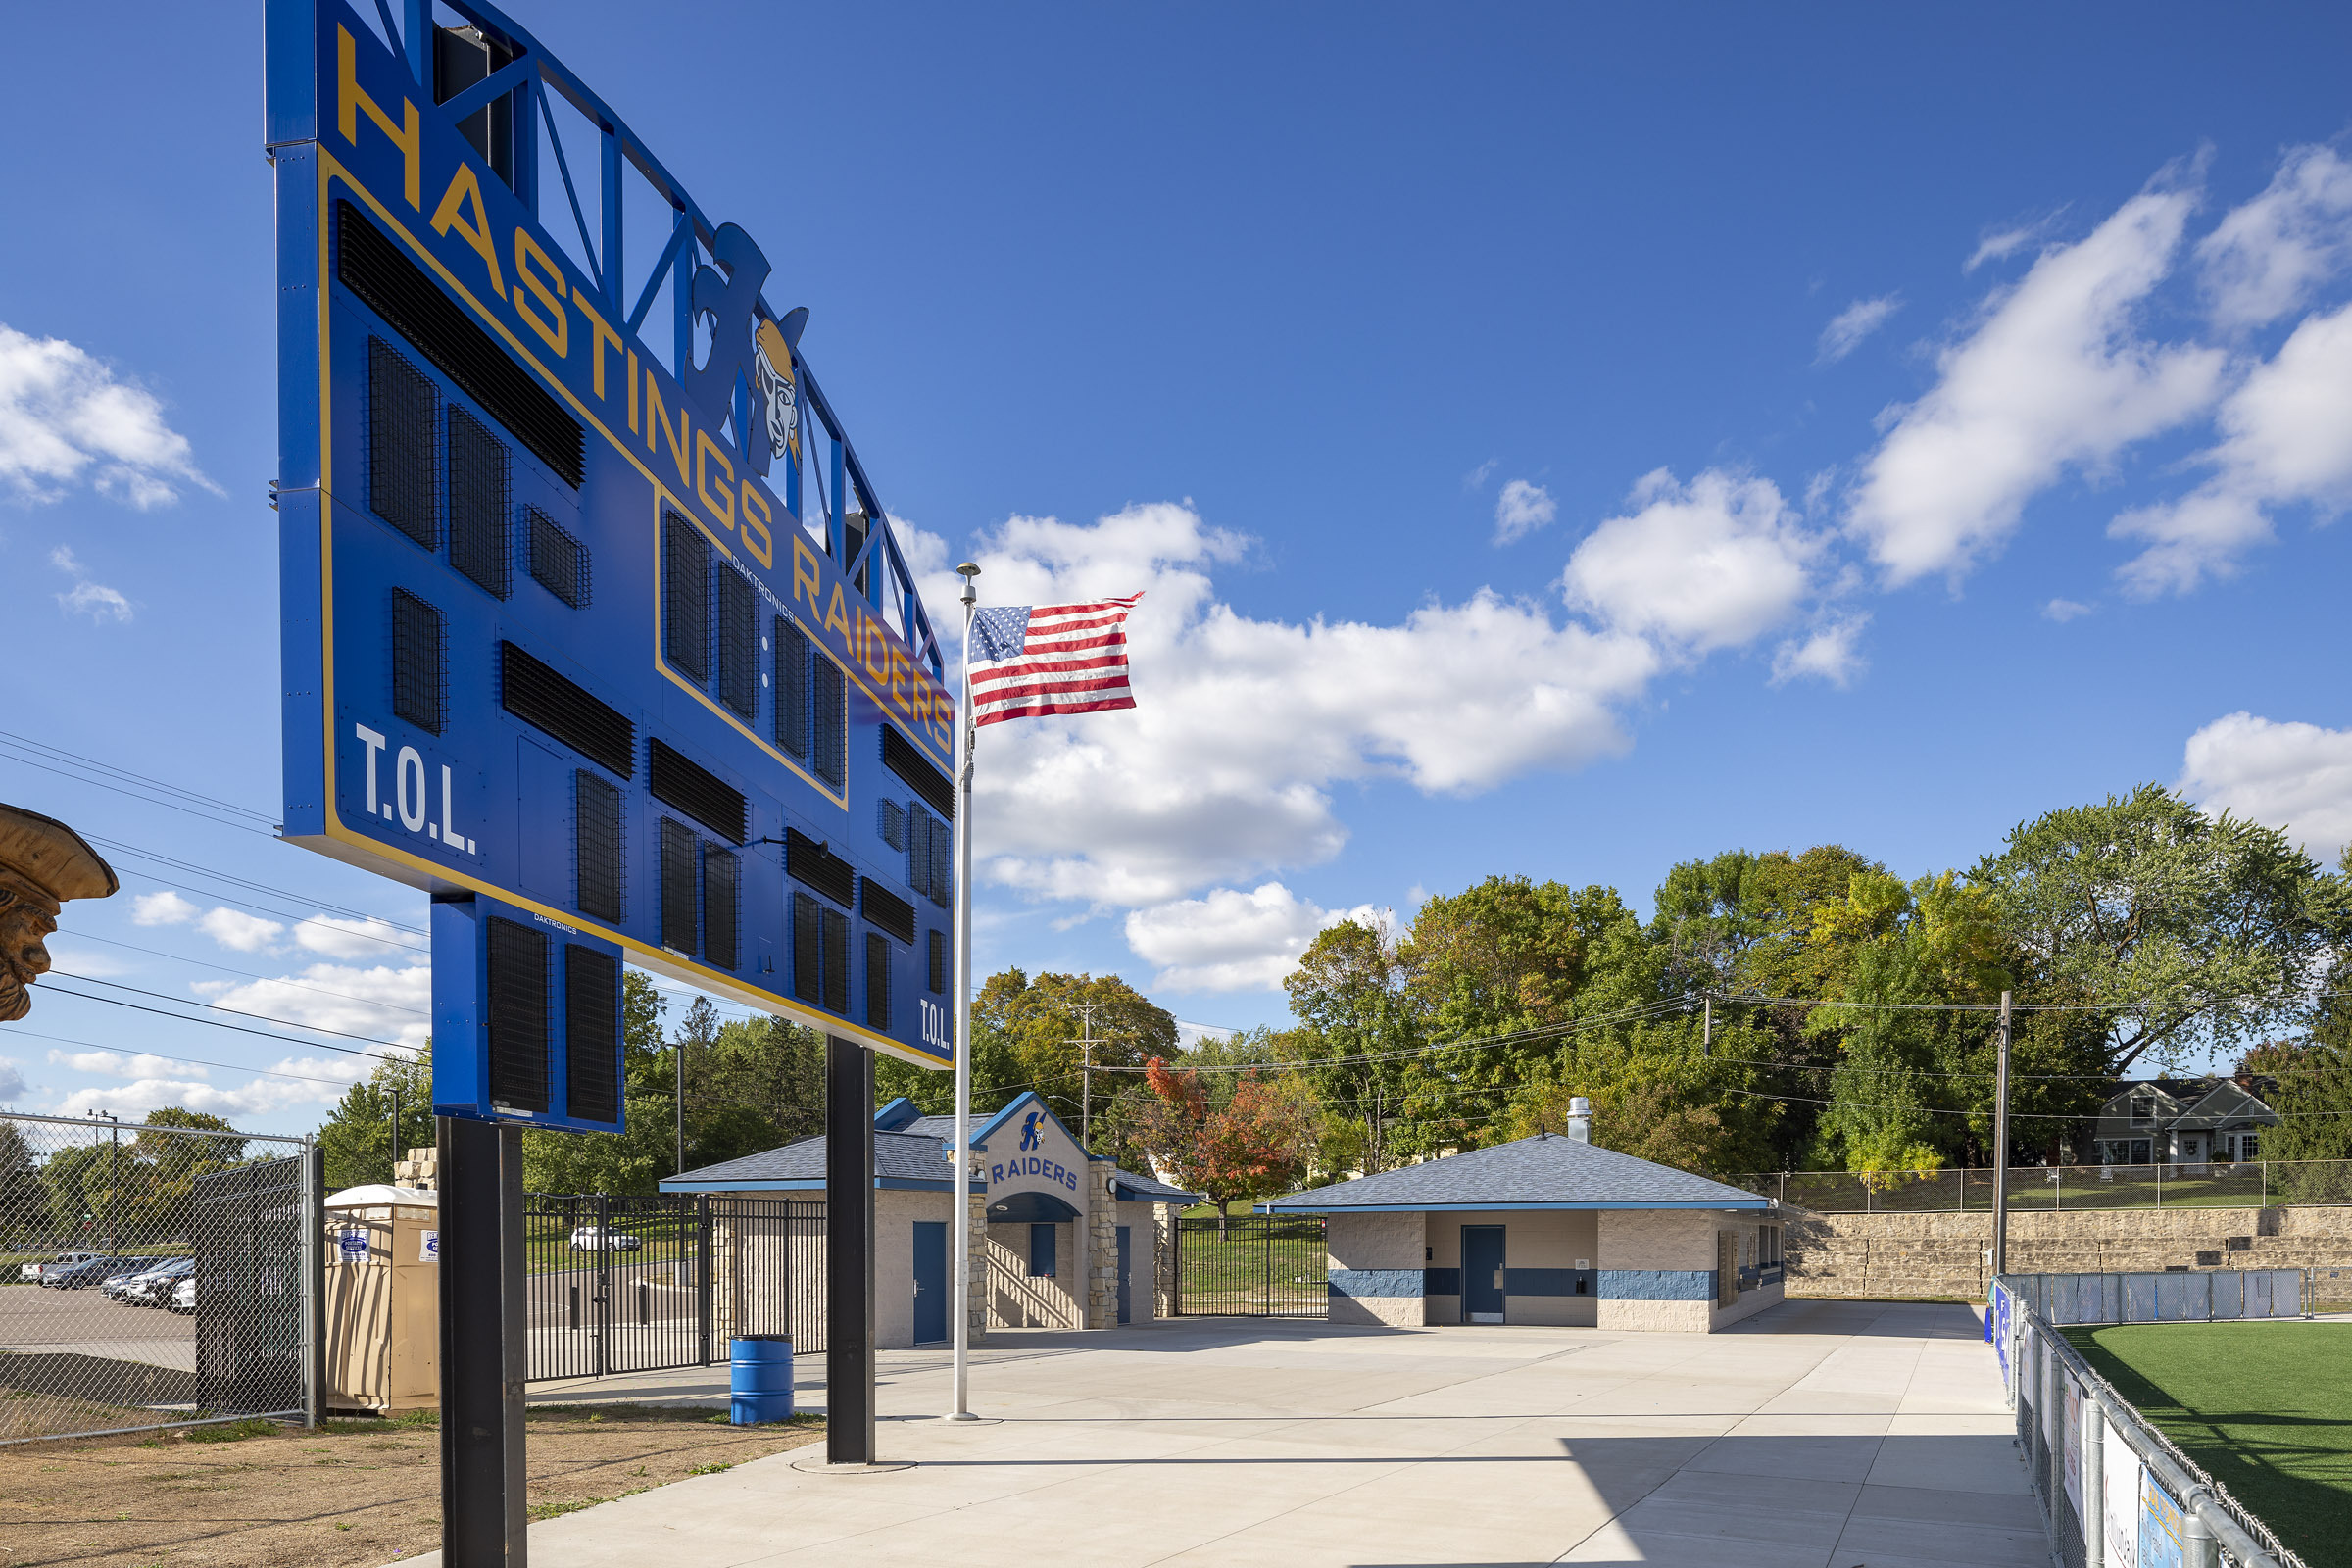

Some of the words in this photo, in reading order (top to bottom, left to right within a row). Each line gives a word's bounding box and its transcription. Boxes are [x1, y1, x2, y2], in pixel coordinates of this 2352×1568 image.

[337, 22, 772, 570] HASTINGS
[793, 533, 952, 755] RAIDERS
[732, 554, 795, 624] DAKTRONICS
[356, 722, 476, 856] T.O.L.
[534, 913, 577, 935] DAKTRONICS
[920, 998, 950, 1051] T.O.L.
[992, 1157, 1077, 1192] RAIDERS
